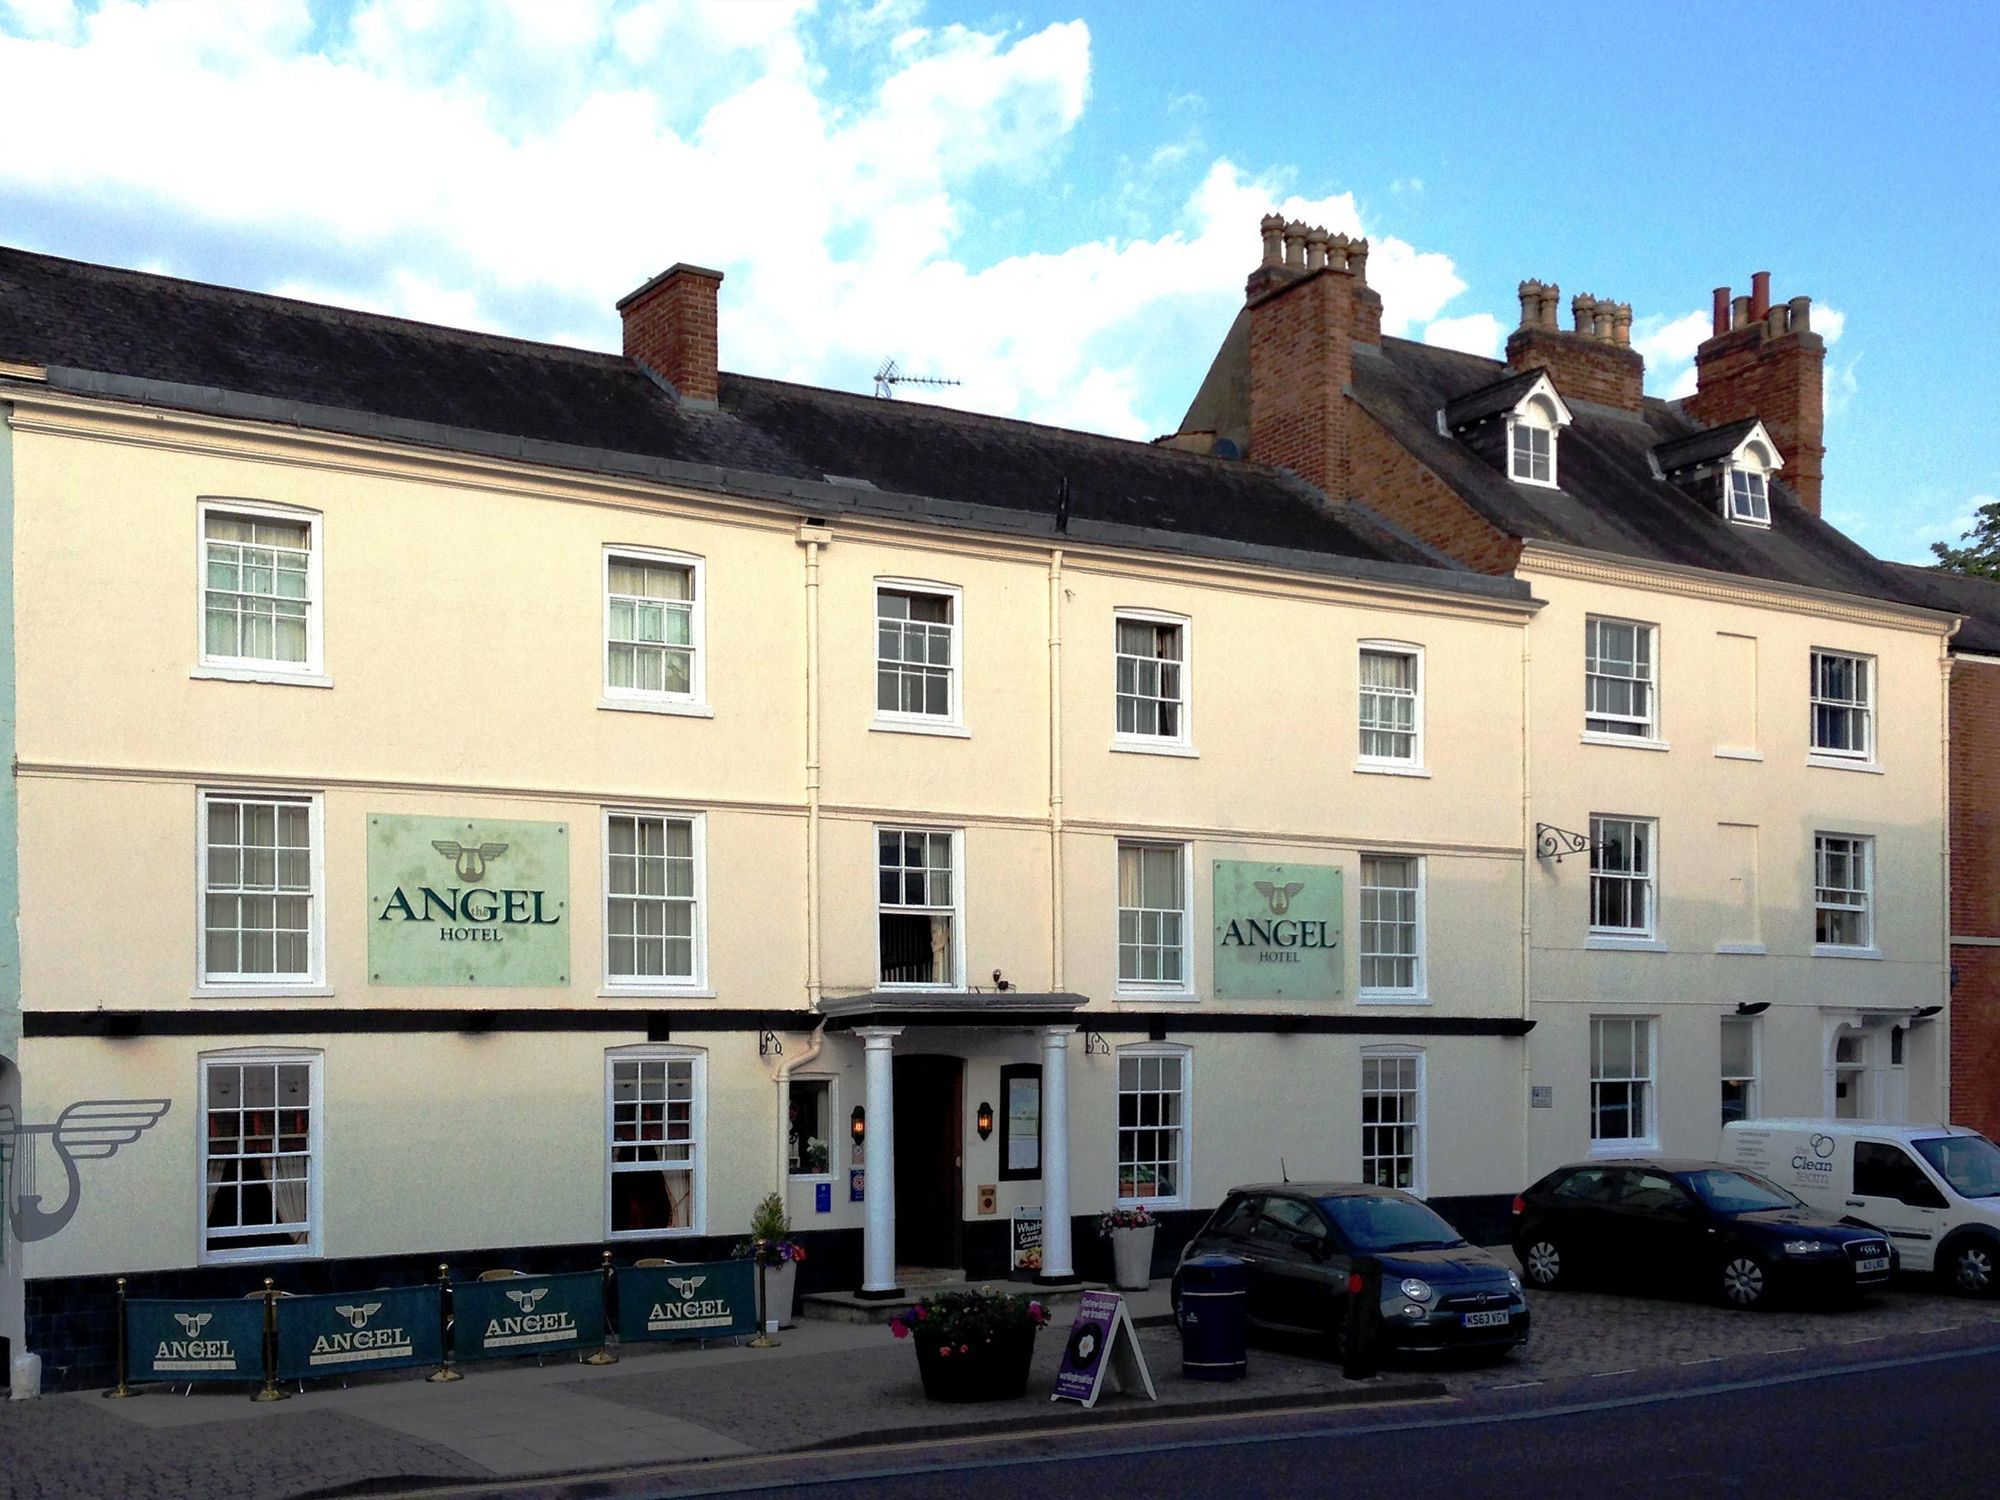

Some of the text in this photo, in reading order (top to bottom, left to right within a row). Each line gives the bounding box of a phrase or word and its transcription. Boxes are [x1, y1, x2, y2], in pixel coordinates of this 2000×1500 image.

[378, 886, 561, 924] ANGEL
[470, 905, 489, 917] the
[439, 928, 503, 942] HOTEL
[1220, 918, 1337, 948] ANGEL
[1260, 951, 1301, 962] HOTEL
[1791, 1155, 1832, 1172] Clean
[1796, 1171, 1829, 1185] team
[1016, 1220, 1042, 1234] Whitb
[648, 1299, 730, 1320] ANGEL
[485, 1311, 576, 1337] ANGEL
[1467, 1313, 1490, 1326] KS63
[311, 1327, 411, 1354] ANGEL
[154, 1340, 235, 1359] ANGEL
